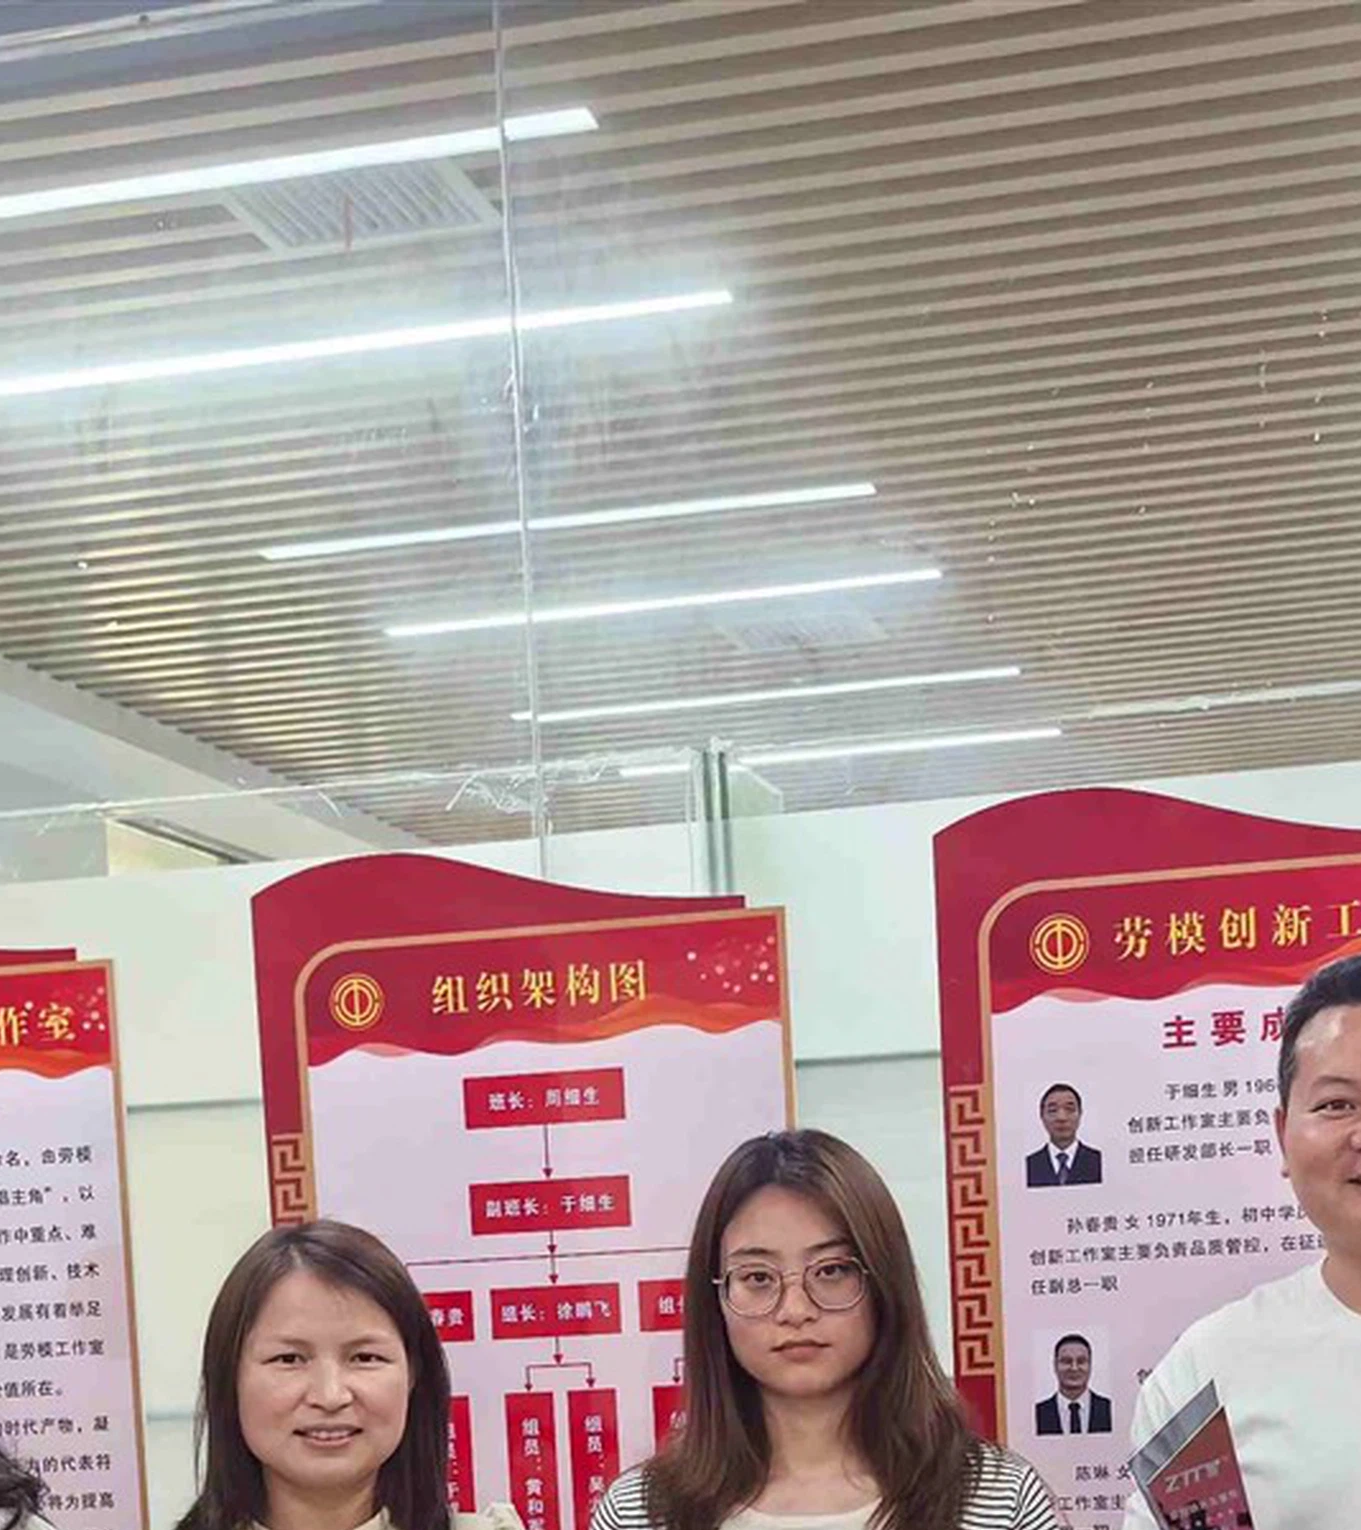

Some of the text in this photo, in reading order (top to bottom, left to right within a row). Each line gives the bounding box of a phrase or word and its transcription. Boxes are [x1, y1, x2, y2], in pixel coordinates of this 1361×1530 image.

[432, 959, 645, 1014] 组织架构图
[1224, 1080, 1238, 1097] 男
[1246, 1078, 1278, 1094] 196
